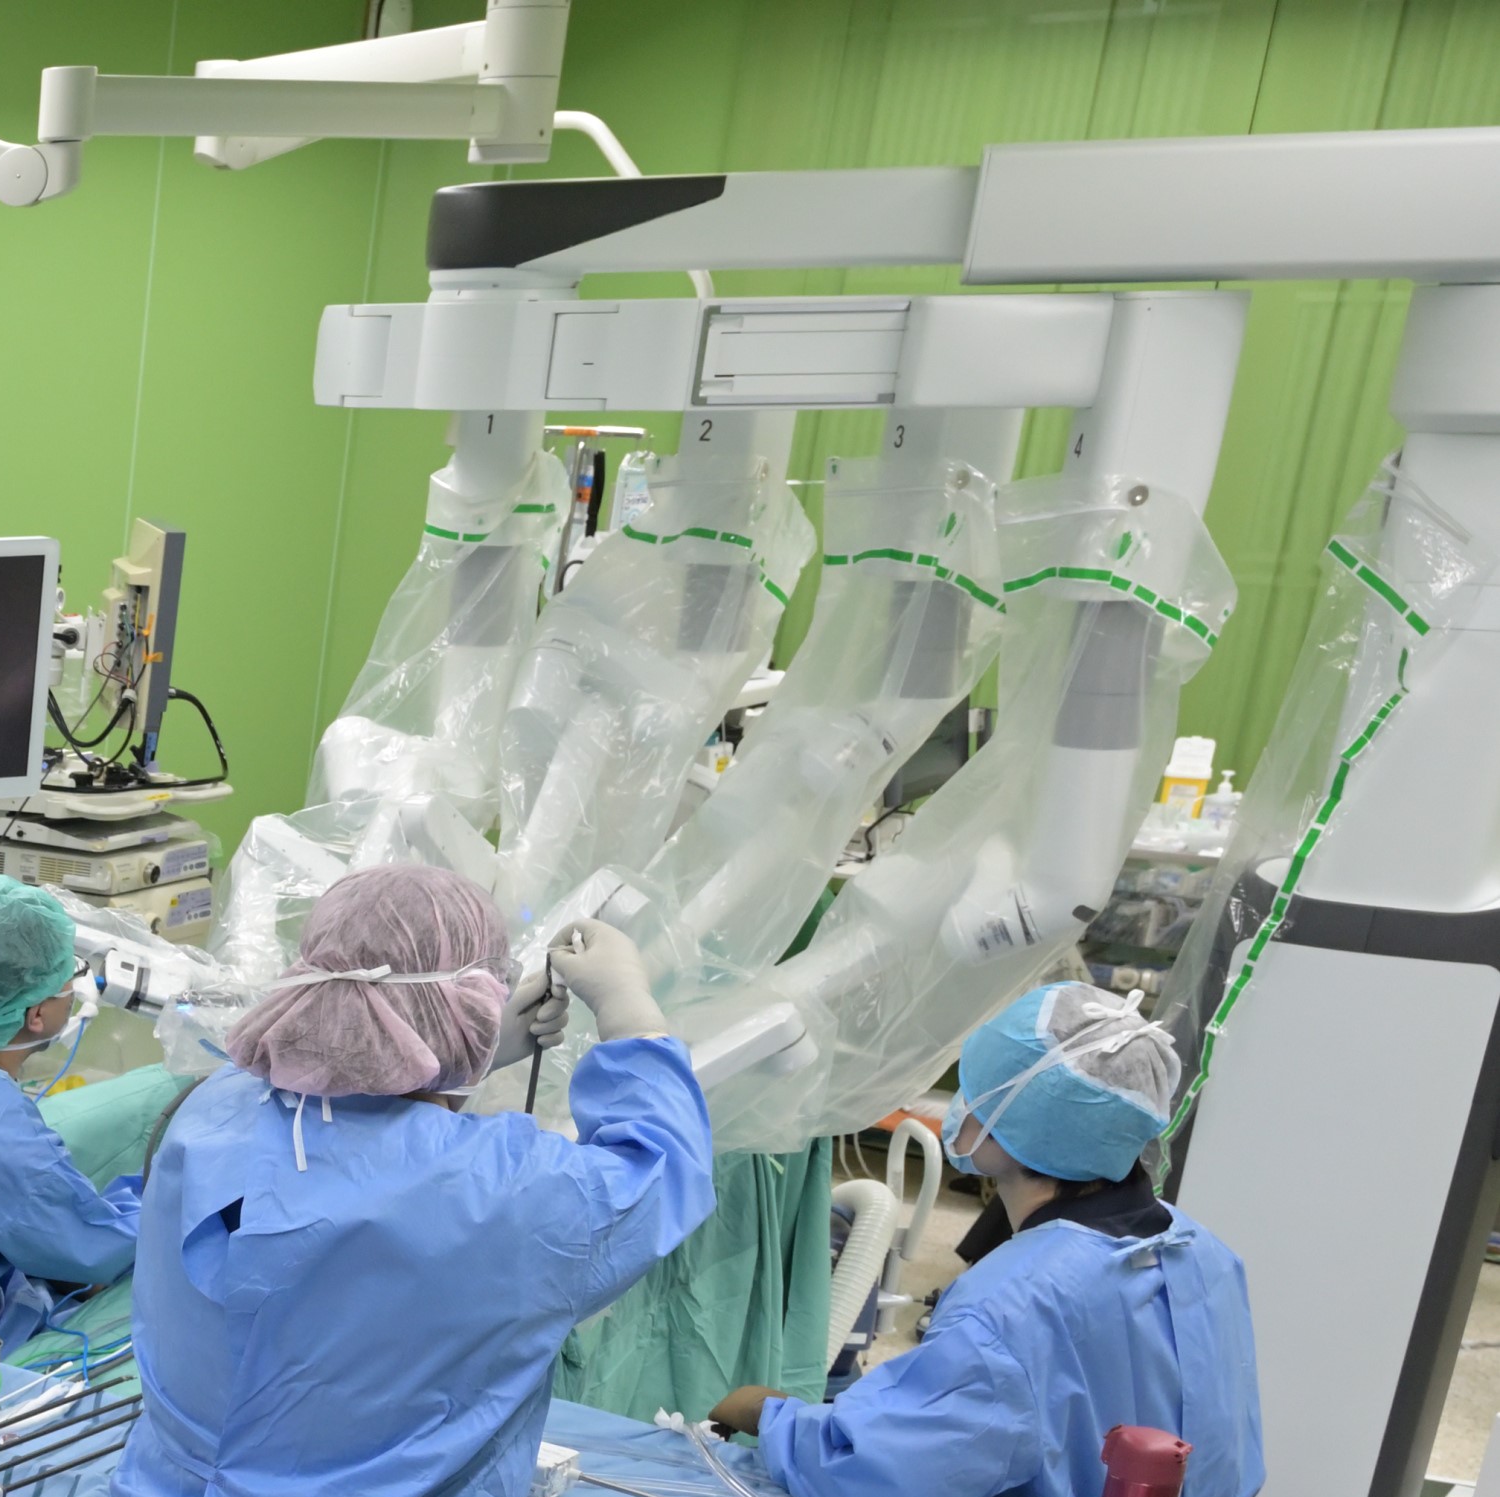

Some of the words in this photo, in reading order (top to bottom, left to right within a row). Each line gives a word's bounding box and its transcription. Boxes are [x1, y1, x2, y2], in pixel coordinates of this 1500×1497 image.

[487, 413, 494, 435] 1
[699, 419, 713, 442] 2
[893, 424, 905, 449] 3
[1074, 433, 1084, 458] 4
